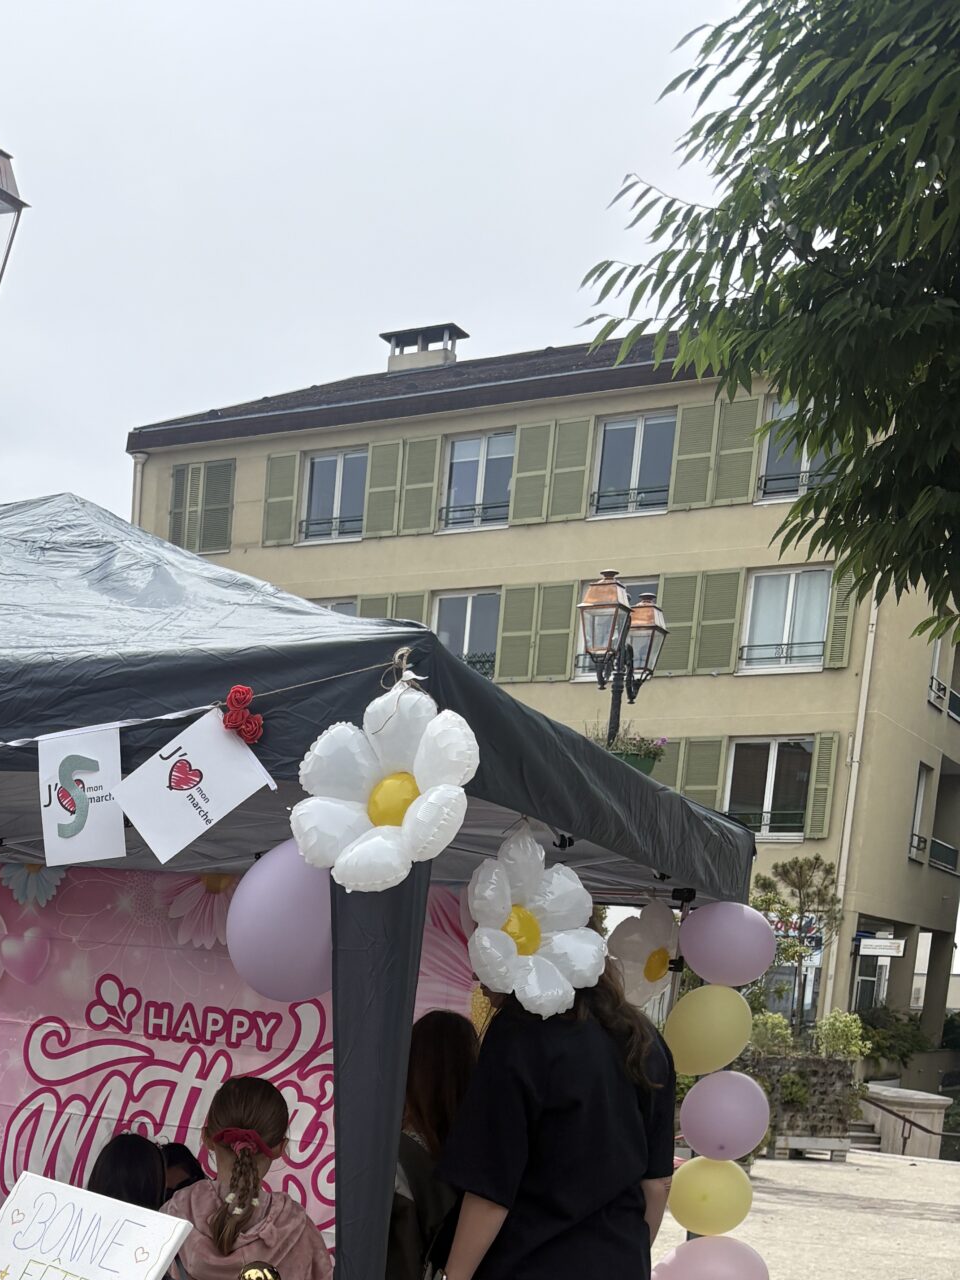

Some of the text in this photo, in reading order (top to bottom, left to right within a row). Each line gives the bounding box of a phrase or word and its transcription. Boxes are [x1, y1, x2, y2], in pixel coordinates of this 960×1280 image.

[86, 784, 103, 793] mon
[195, 785, 211, 804] mon
[186, 792, 214, 826] marché
[145, 1002, 281, 1050] HAPPY
[12, 1191, 147, 1273] BONNE
